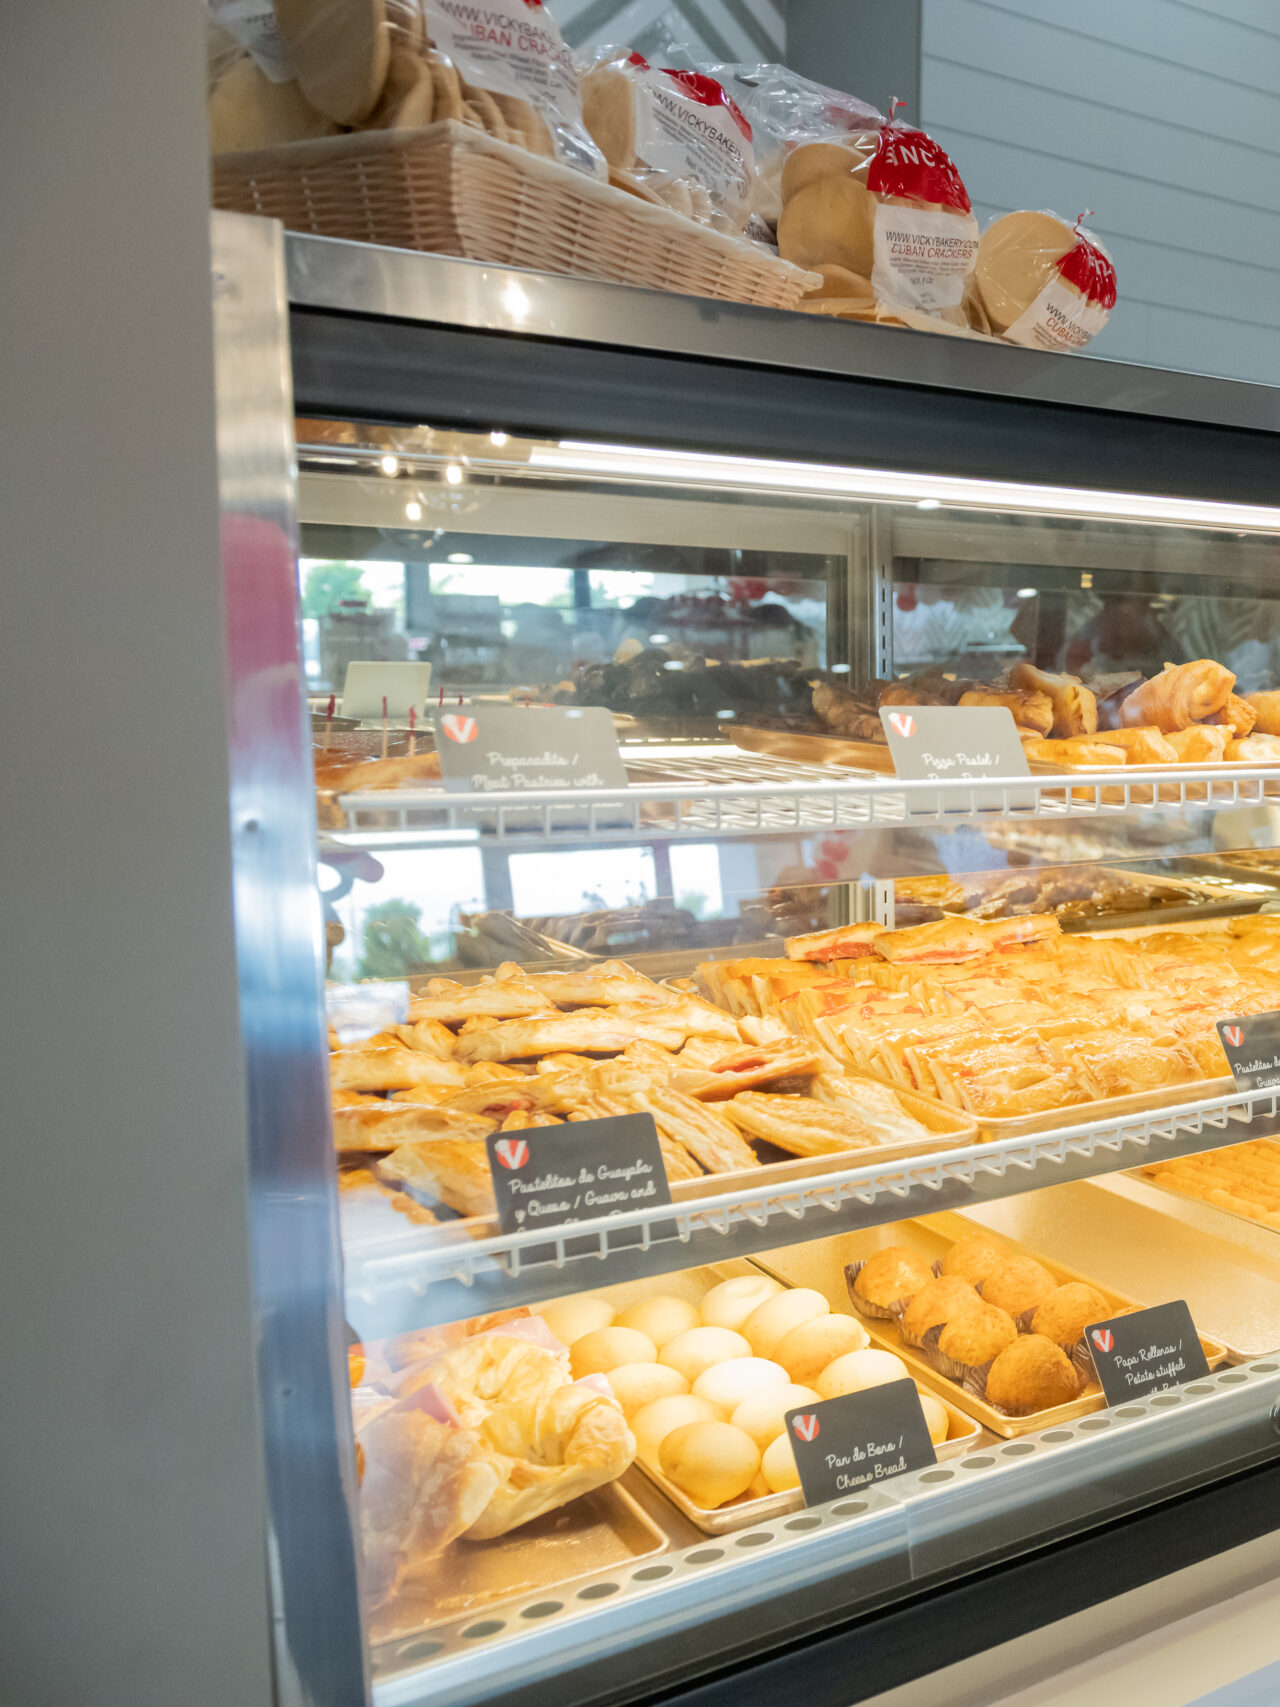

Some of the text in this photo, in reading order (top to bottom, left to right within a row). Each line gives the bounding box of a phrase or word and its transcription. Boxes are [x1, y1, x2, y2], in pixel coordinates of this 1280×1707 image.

[891, 243, 974, 260] CUBAN CRACKERS
[921, 753, 956, 770] Pizza
[955, 752, 992, 766] Pastel
[573, 773, 605, 787] with
[1234, 1059, 1273, 1074] Pastelitos
[507, 1159, 653, 1195] Pastelitos de Guayaba
[514, 1209, 527, 1224] y
[527, 1200, 572, 1217] Queso
[584, 1191, 629, 1206] Guava
[631, 1180, 657, 1197] and
[1113, 1355, 1139, 1371] Papa
[1124, 1357, 1186, 1386] Potato stuffed
[825, 1454, 851, 1470] Pan
[852, 1446, 867, 1462] de
[836, 1456, 908, 1490] Cheese Bread
